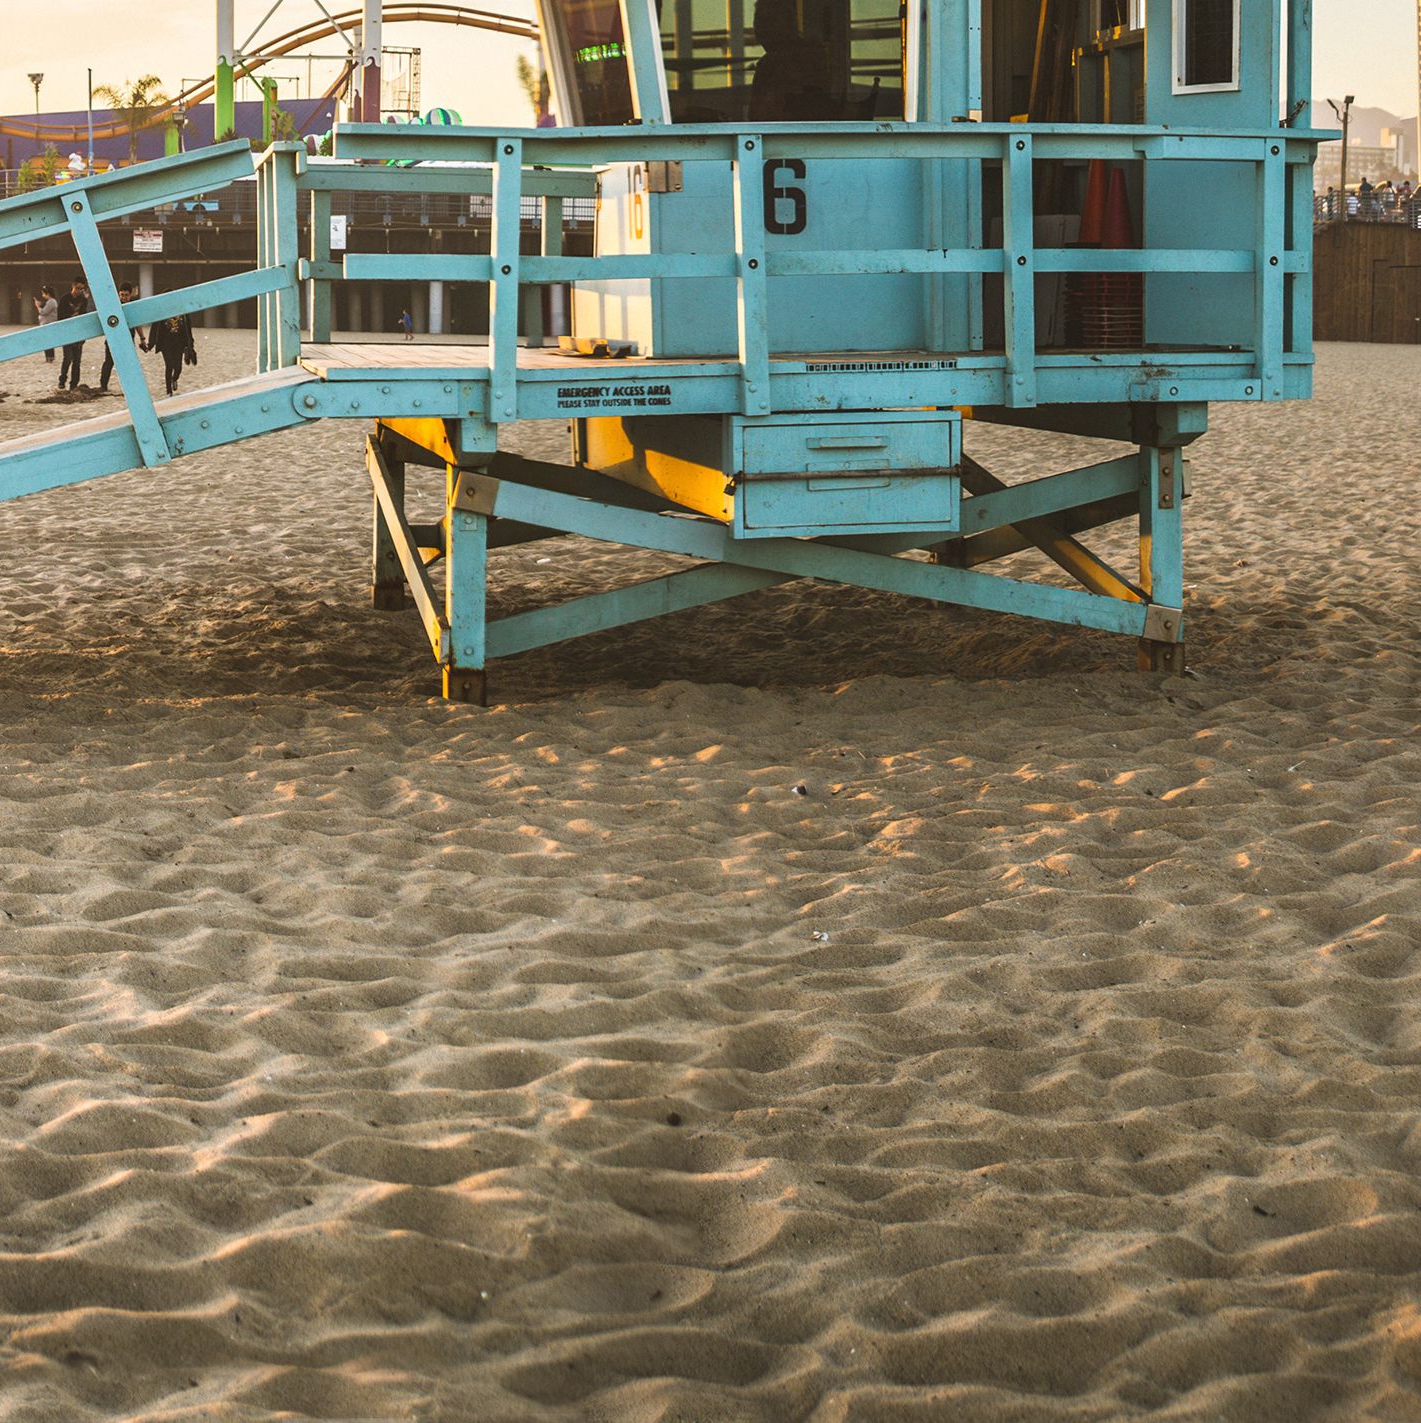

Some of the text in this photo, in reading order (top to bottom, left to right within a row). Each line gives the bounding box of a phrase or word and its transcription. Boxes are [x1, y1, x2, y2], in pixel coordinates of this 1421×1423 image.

[557, 385, 671, 398] EMERGENCY ACCESS AREA
[557, 397, 671, 408] PLEASE STAY OUTSIDE THE CONES
